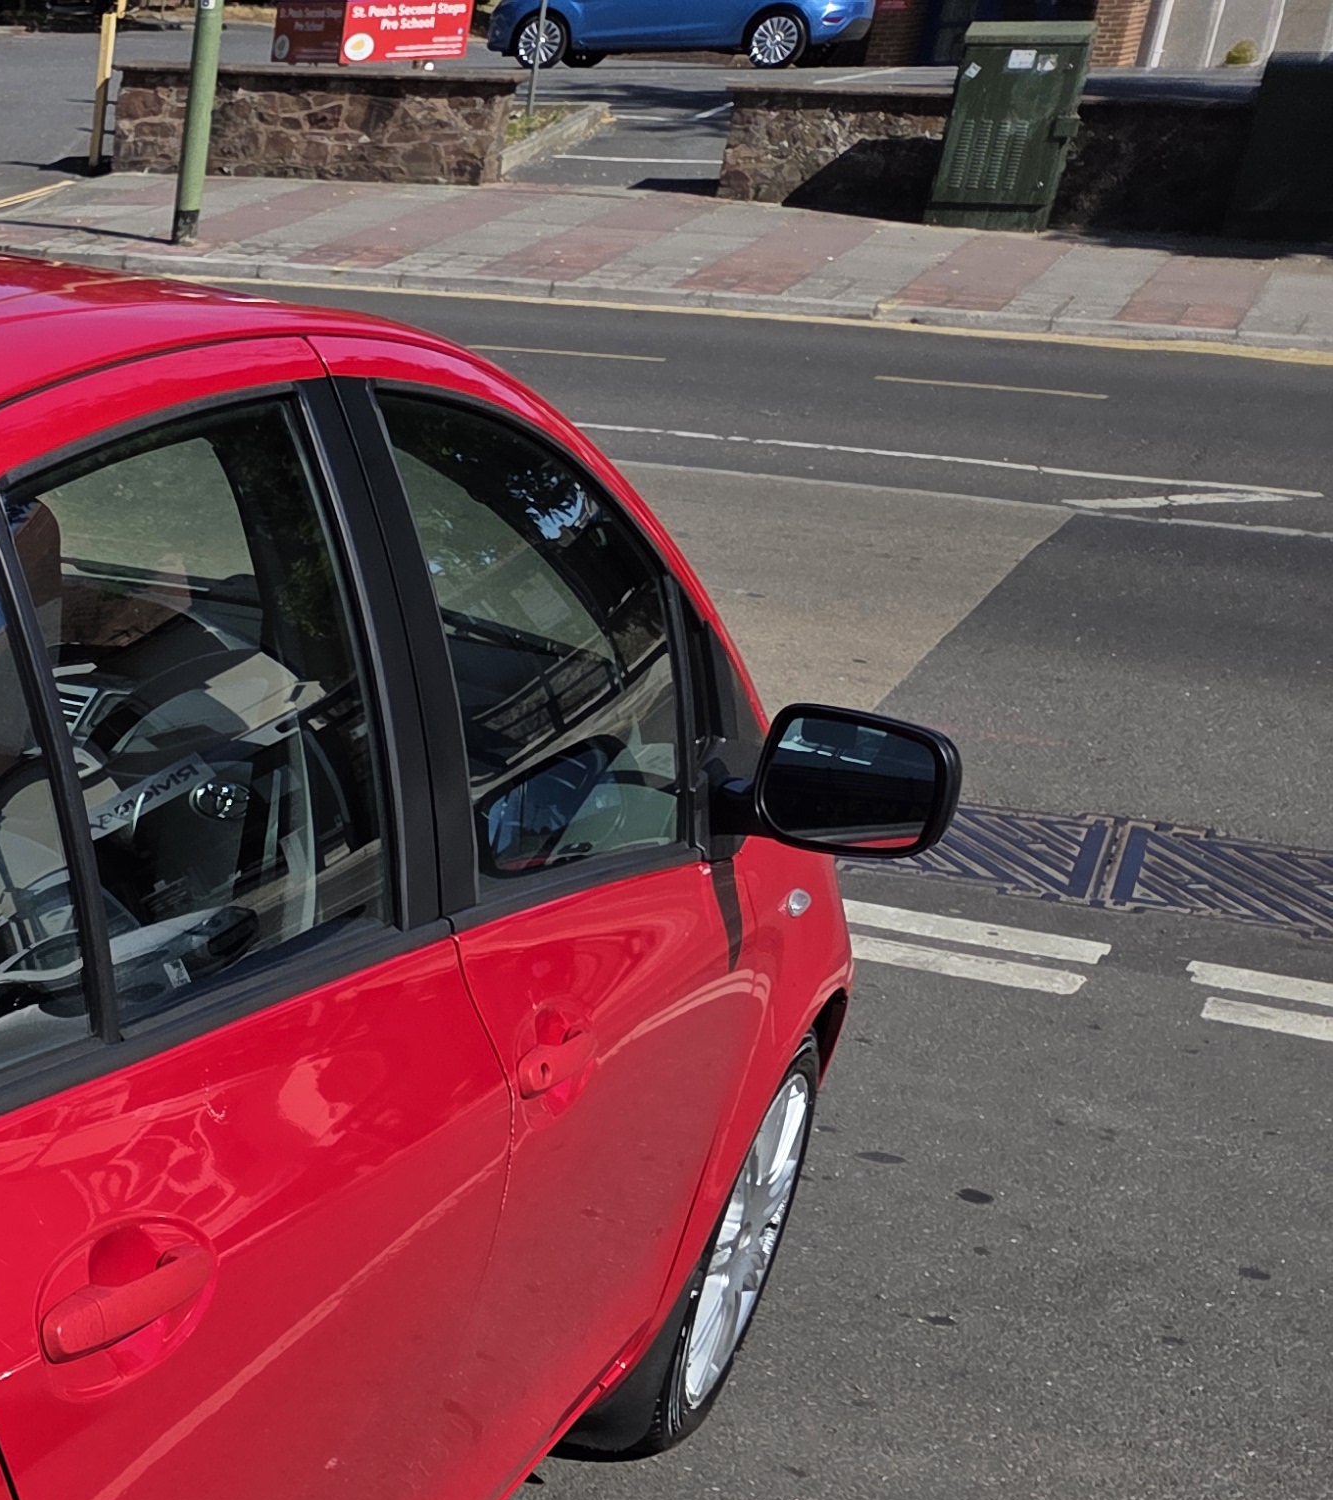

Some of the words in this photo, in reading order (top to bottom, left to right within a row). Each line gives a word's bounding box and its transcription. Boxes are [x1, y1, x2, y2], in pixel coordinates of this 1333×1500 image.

[398, 3, 437, 16] Second
[437, 3, 467, 16] Steps
[380, 18, 399, 30] Pre
[400, 16, 436, 29] School
